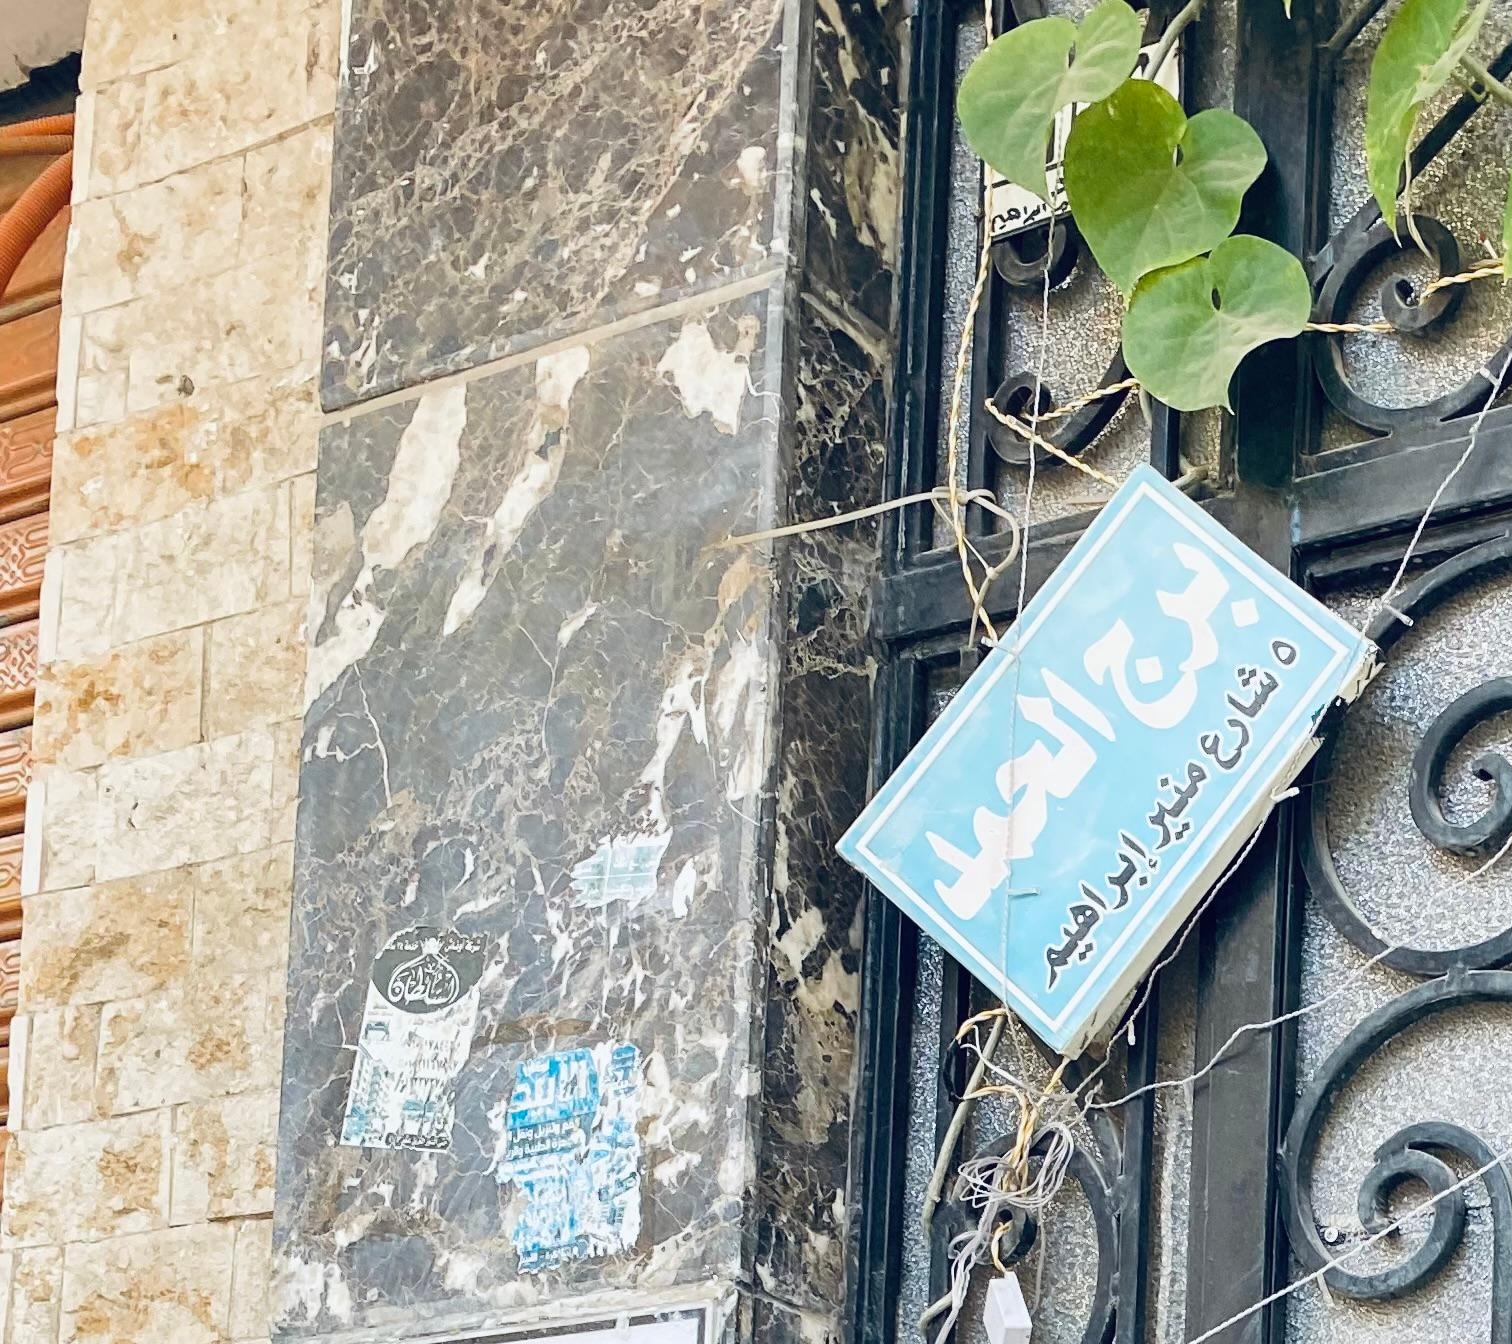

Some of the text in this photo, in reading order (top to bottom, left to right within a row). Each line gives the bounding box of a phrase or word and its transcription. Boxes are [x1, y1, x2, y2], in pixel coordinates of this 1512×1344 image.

[926, 543, 1260, 921] برج الحمد
[1045, 640, 1297, 991] ٥ شارع منير إبراهيم
